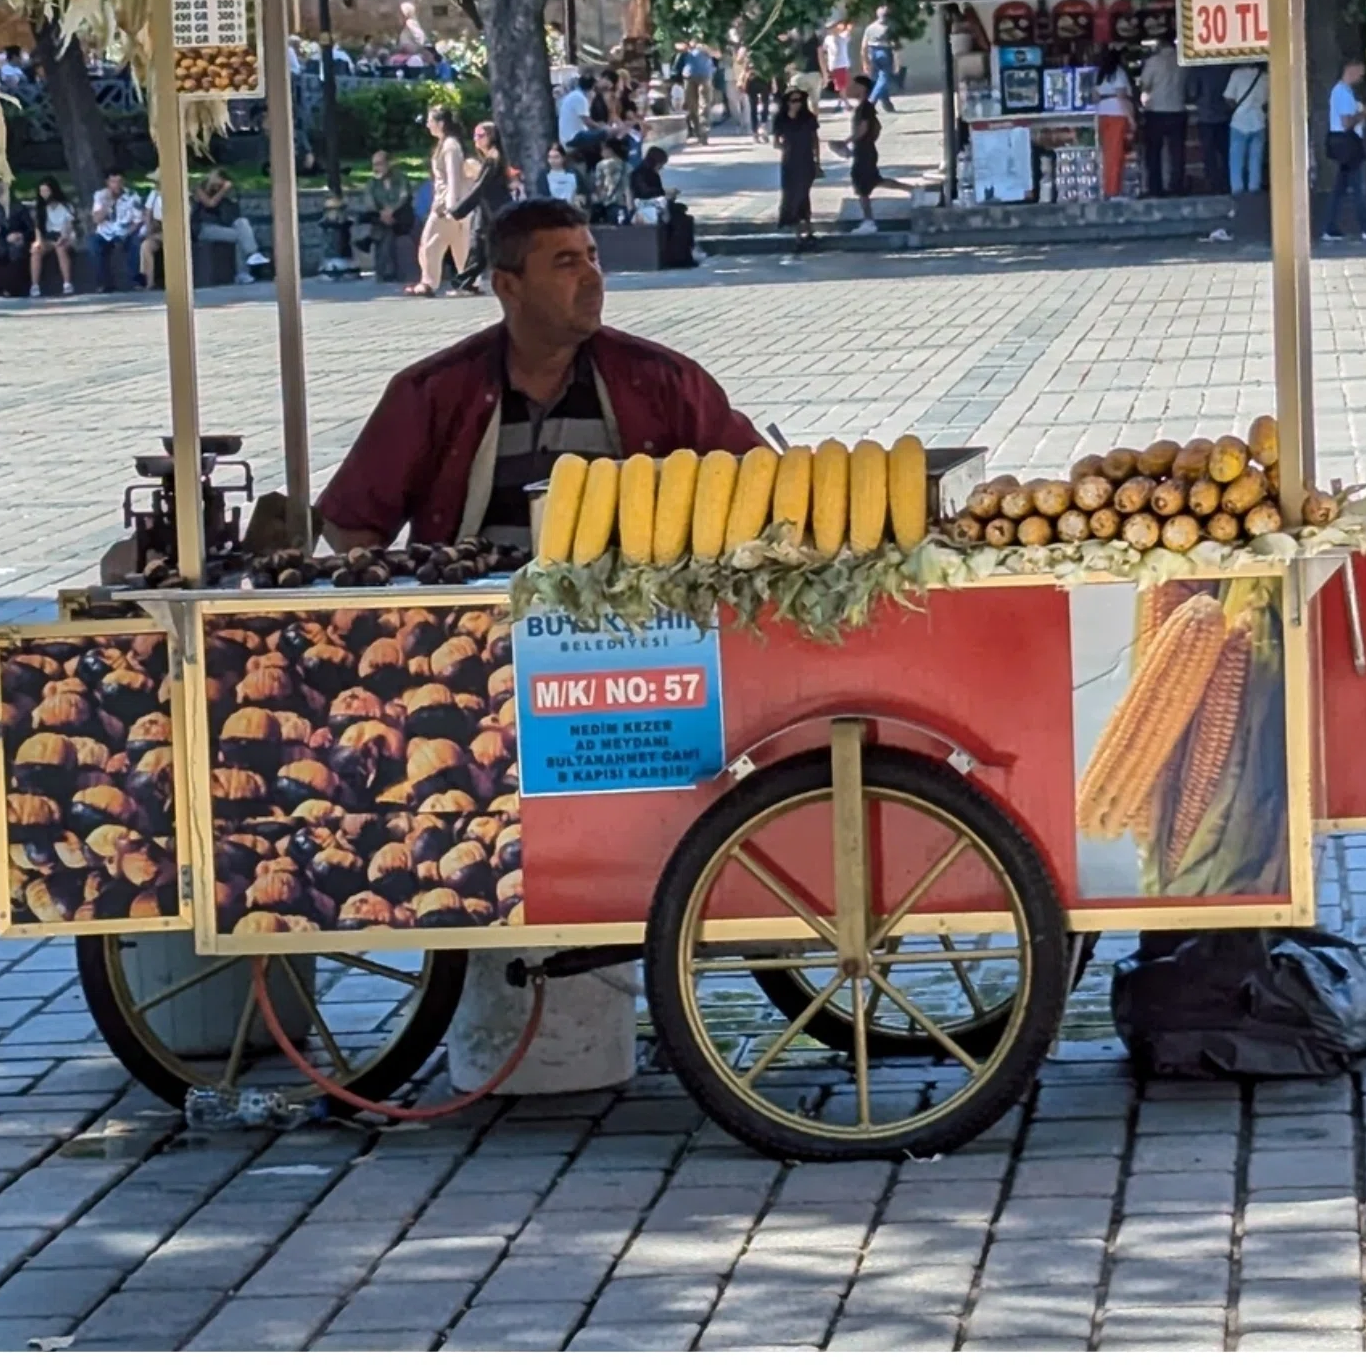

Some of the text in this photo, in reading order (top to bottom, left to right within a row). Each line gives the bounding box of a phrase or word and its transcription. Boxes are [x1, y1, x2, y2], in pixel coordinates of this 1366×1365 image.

[1197, 2, 1268, 45] 30 TL
[535, 674, 700, 708] M/K/ NO: 57
[570, 721, 617, 736] NEDİM
